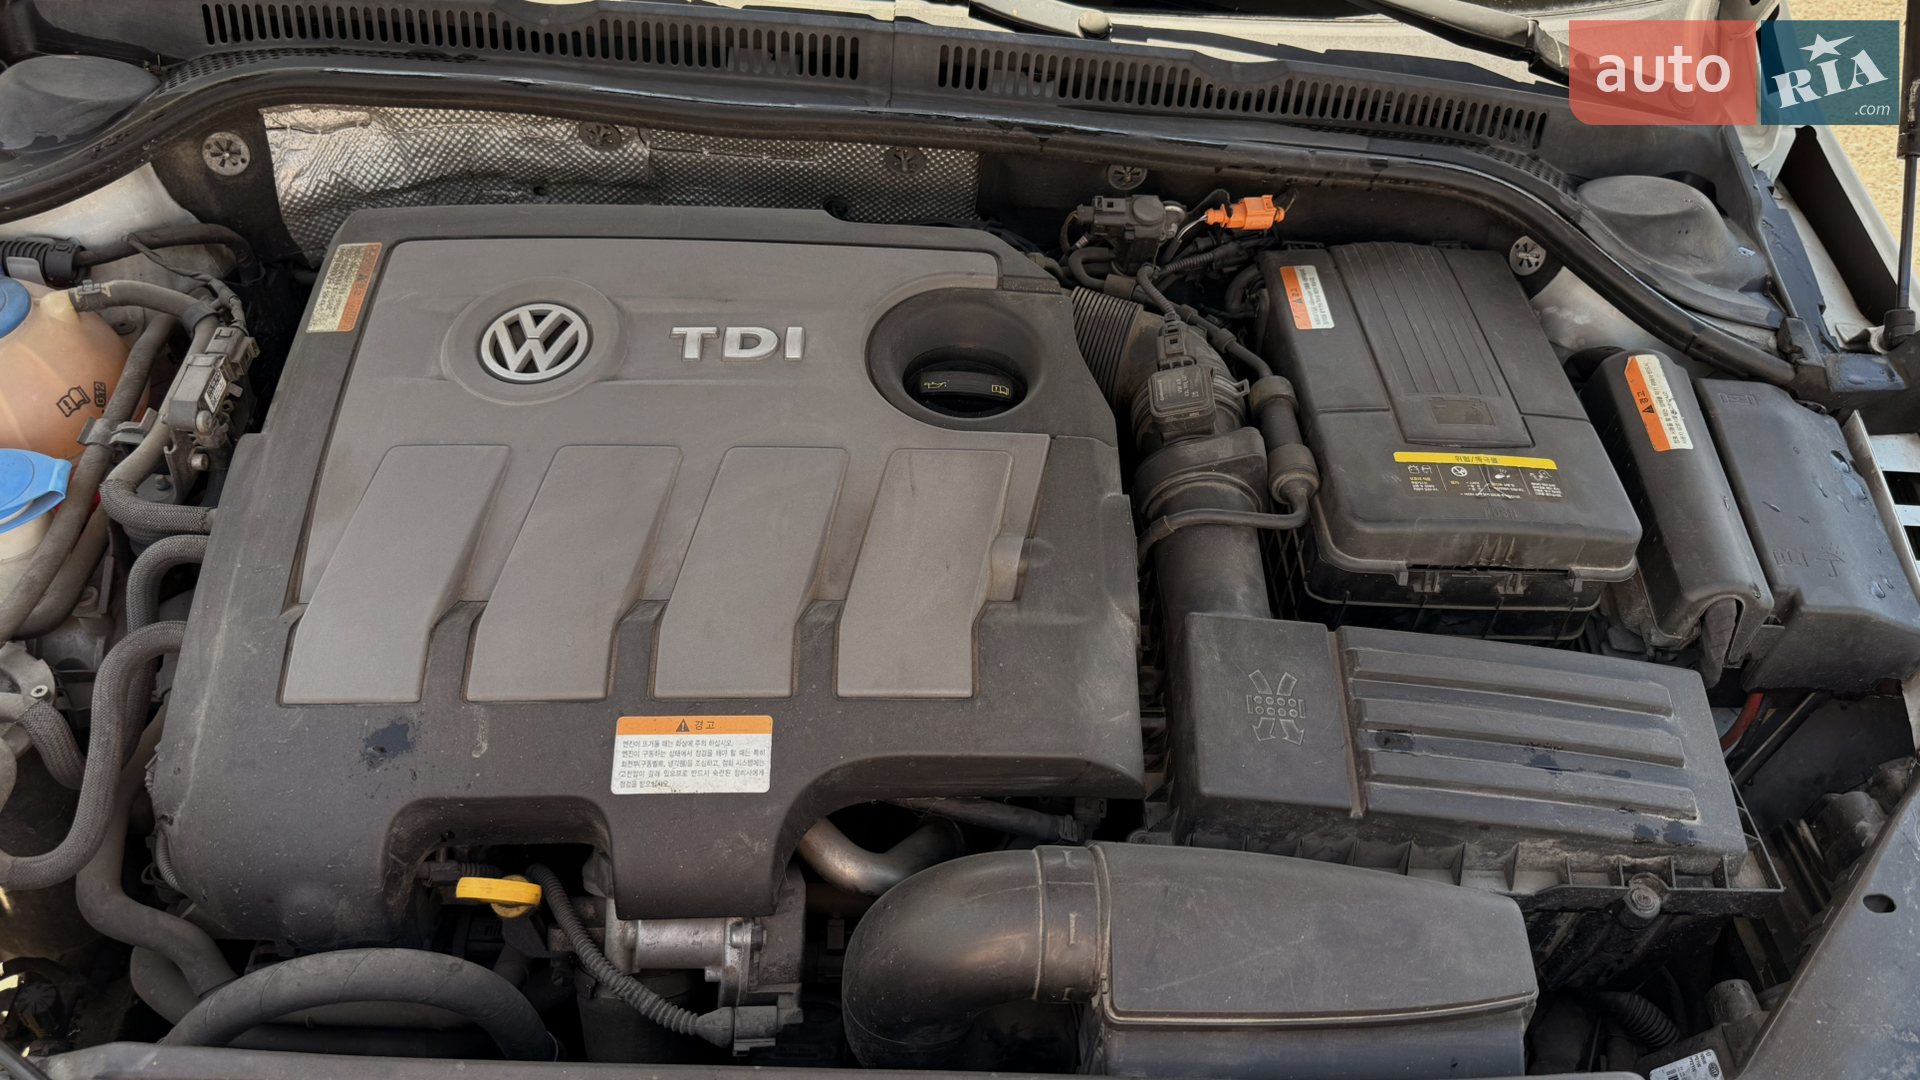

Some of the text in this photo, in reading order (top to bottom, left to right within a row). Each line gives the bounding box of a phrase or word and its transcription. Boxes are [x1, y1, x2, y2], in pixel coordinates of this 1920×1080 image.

[669, 326, 806, 362] TDI
[95, 382, 105, 406] G12
[1637, 390, 1648, 404] 경고
[694, 720, 715, 731] 경고
[623, 740, 640, 748] 엔진이
[622, 750, 639, 758] 엔진이
